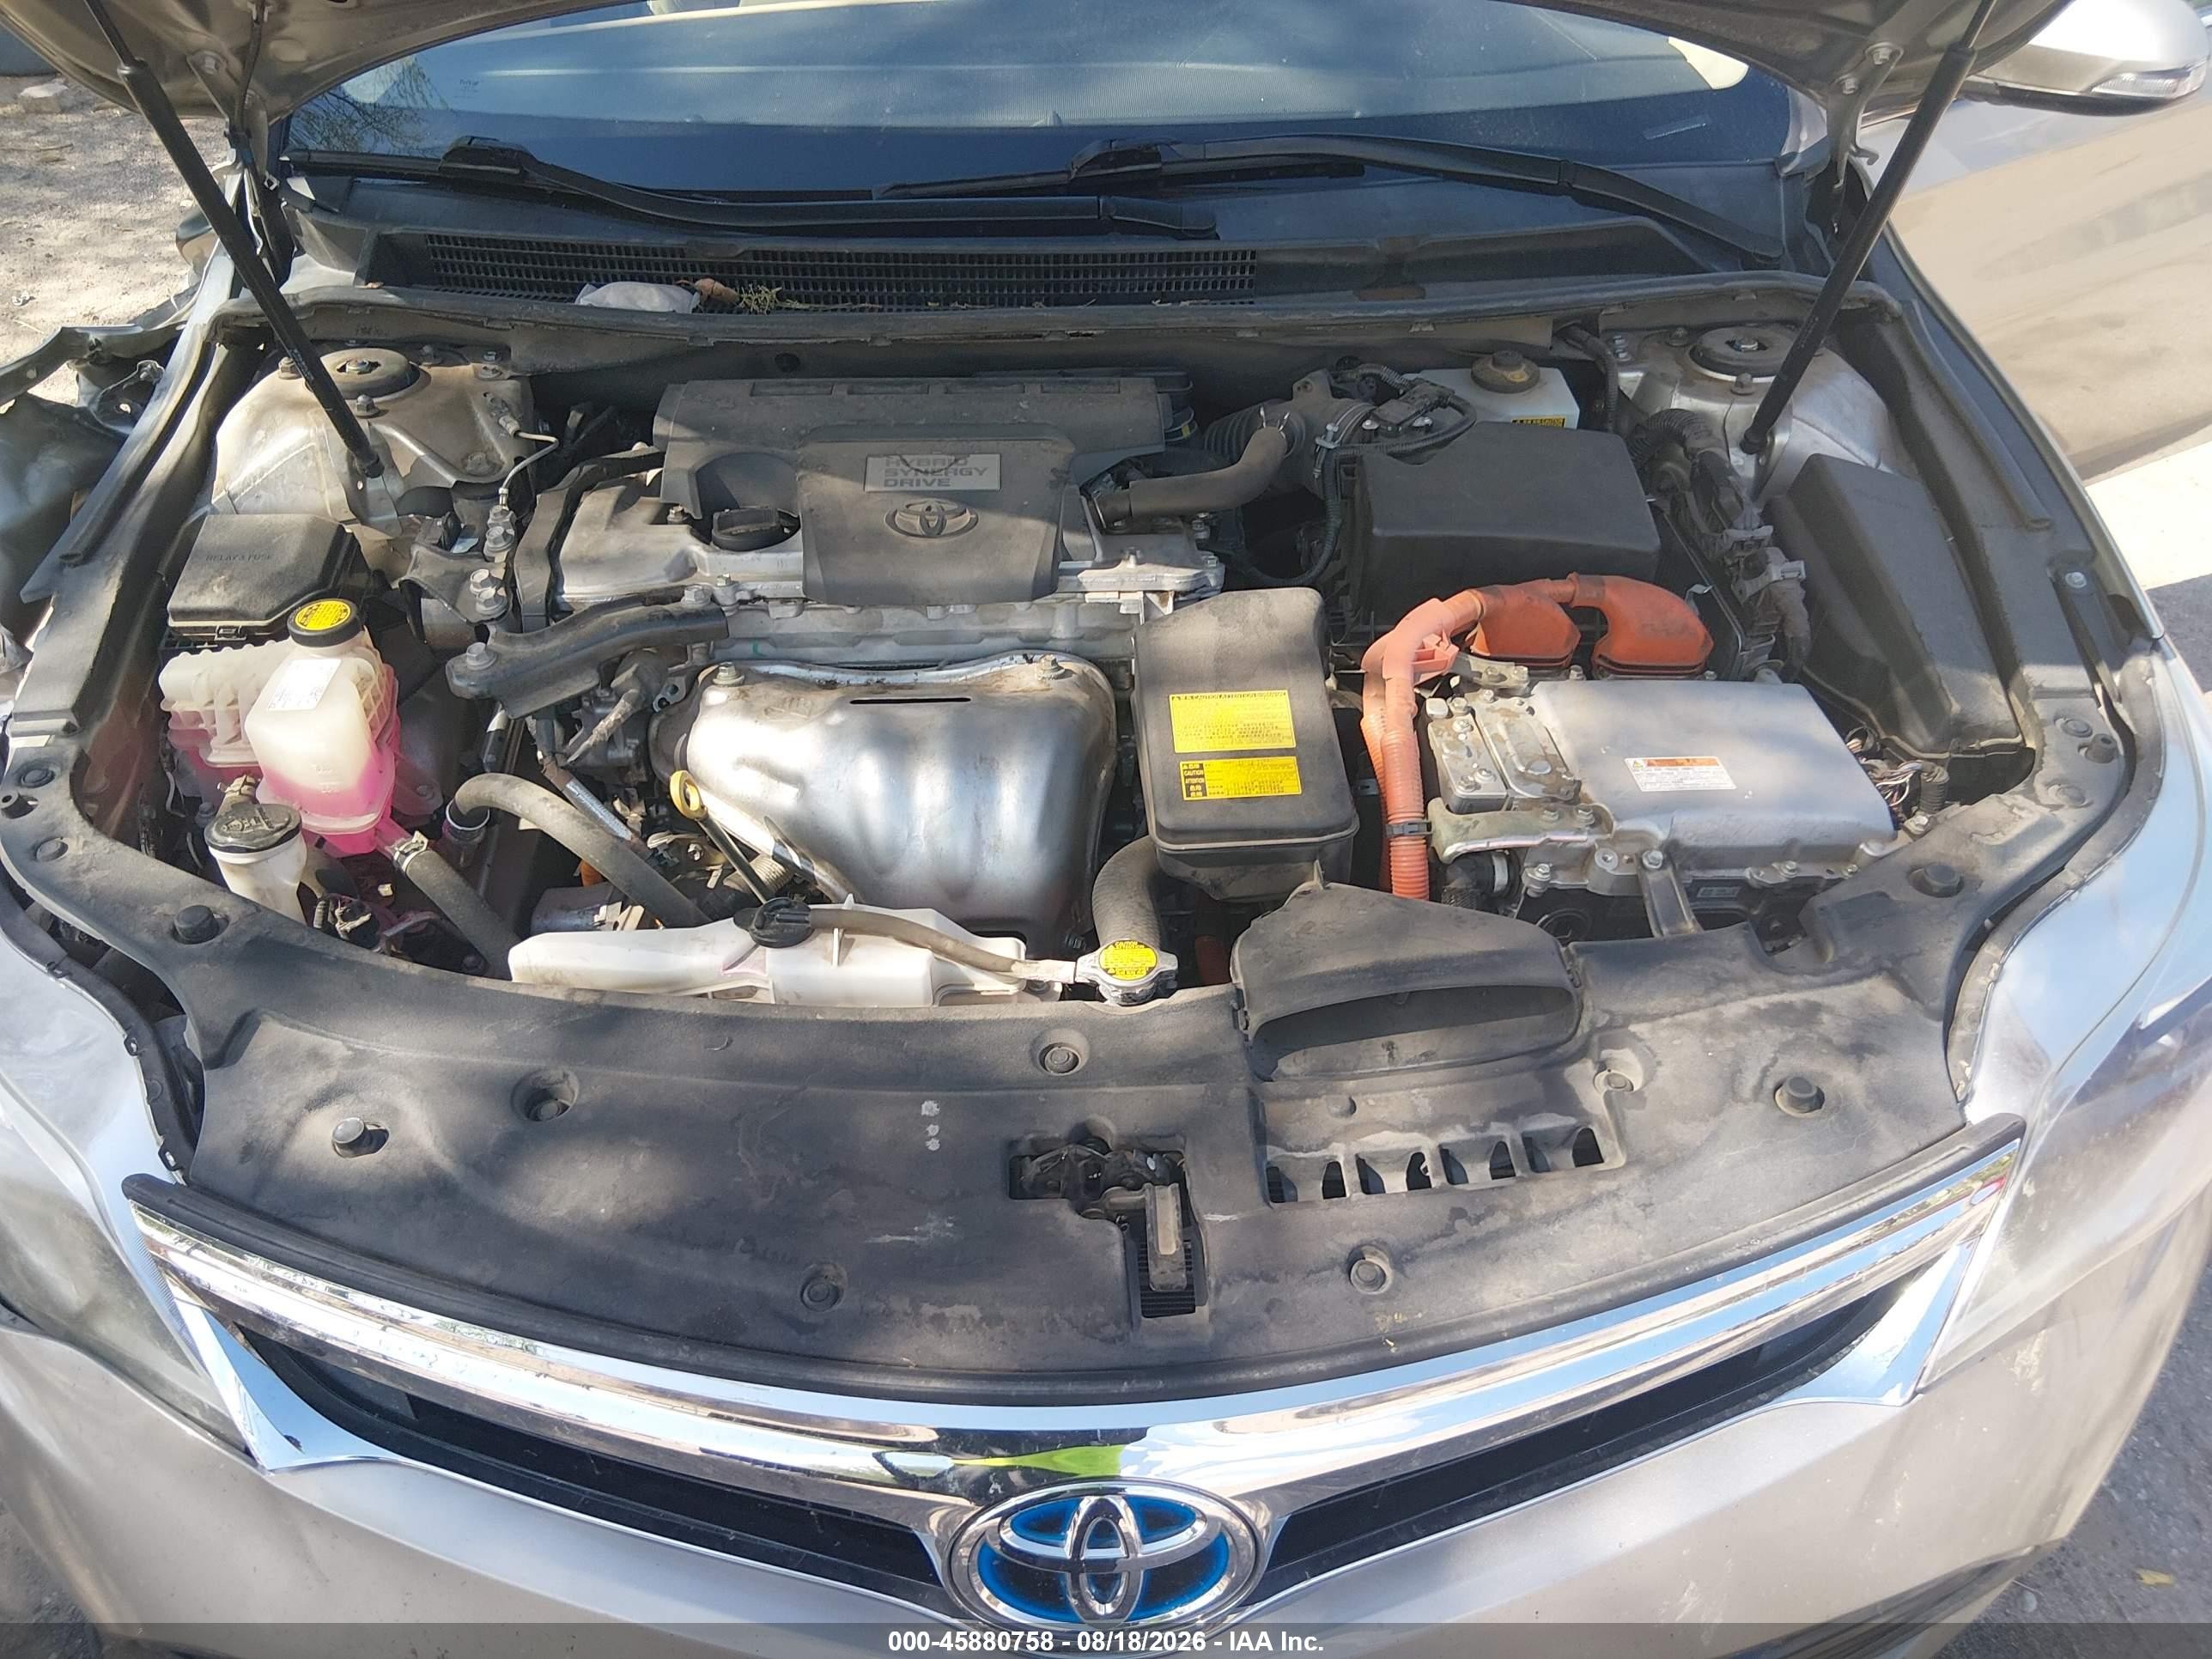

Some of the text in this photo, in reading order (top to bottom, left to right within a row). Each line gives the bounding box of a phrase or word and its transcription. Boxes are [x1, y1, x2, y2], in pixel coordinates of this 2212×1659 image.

[885, 458, 969, 467] HYBRID
[884, 467, 988, 477] SYNERGY
[883, 478, 951, 488] DRIVE
